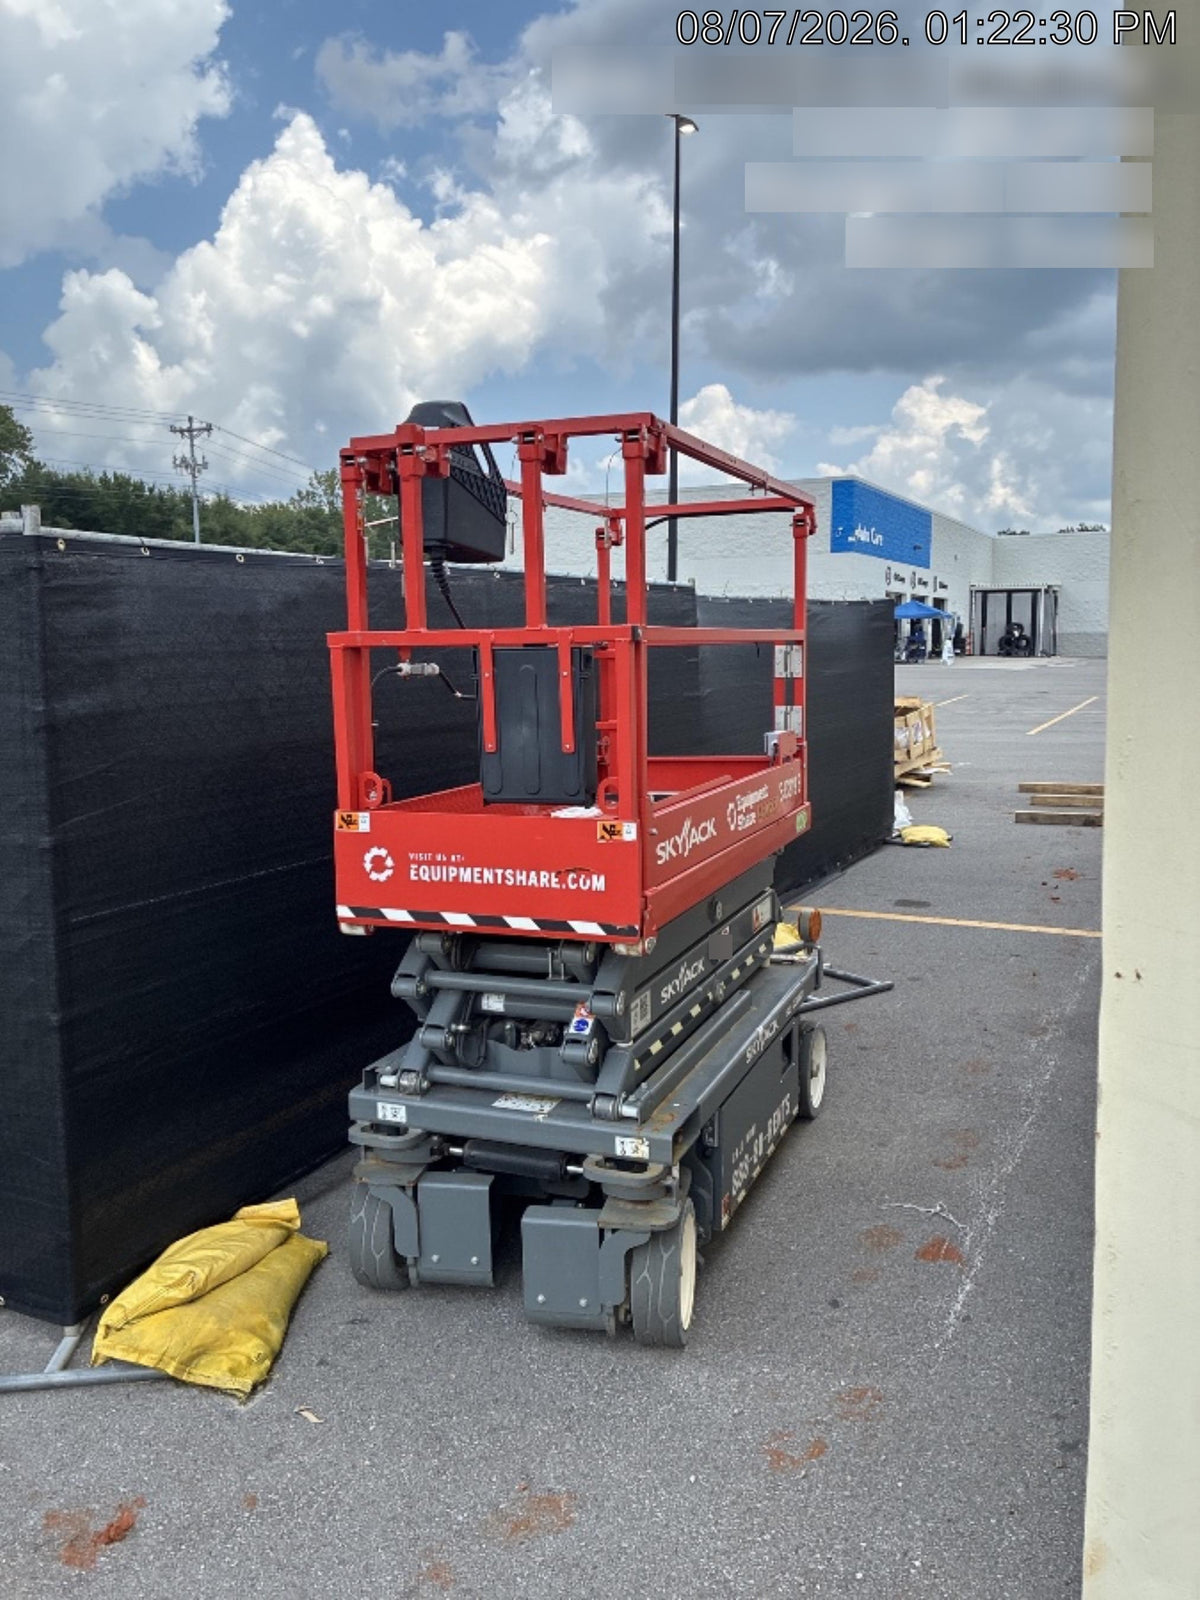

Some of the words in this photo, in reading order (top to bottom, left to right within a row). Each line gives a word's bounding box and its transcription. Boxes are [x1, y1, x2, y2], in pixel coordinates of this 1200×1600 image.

[408, 852, 432, 861] VISIT
[655, 814, 717, 865] SKYJACK
[409, 863, 606, 892] EQUIPMENTSHARE.COM
[660, 956, 705, 1006] SKYJACK
